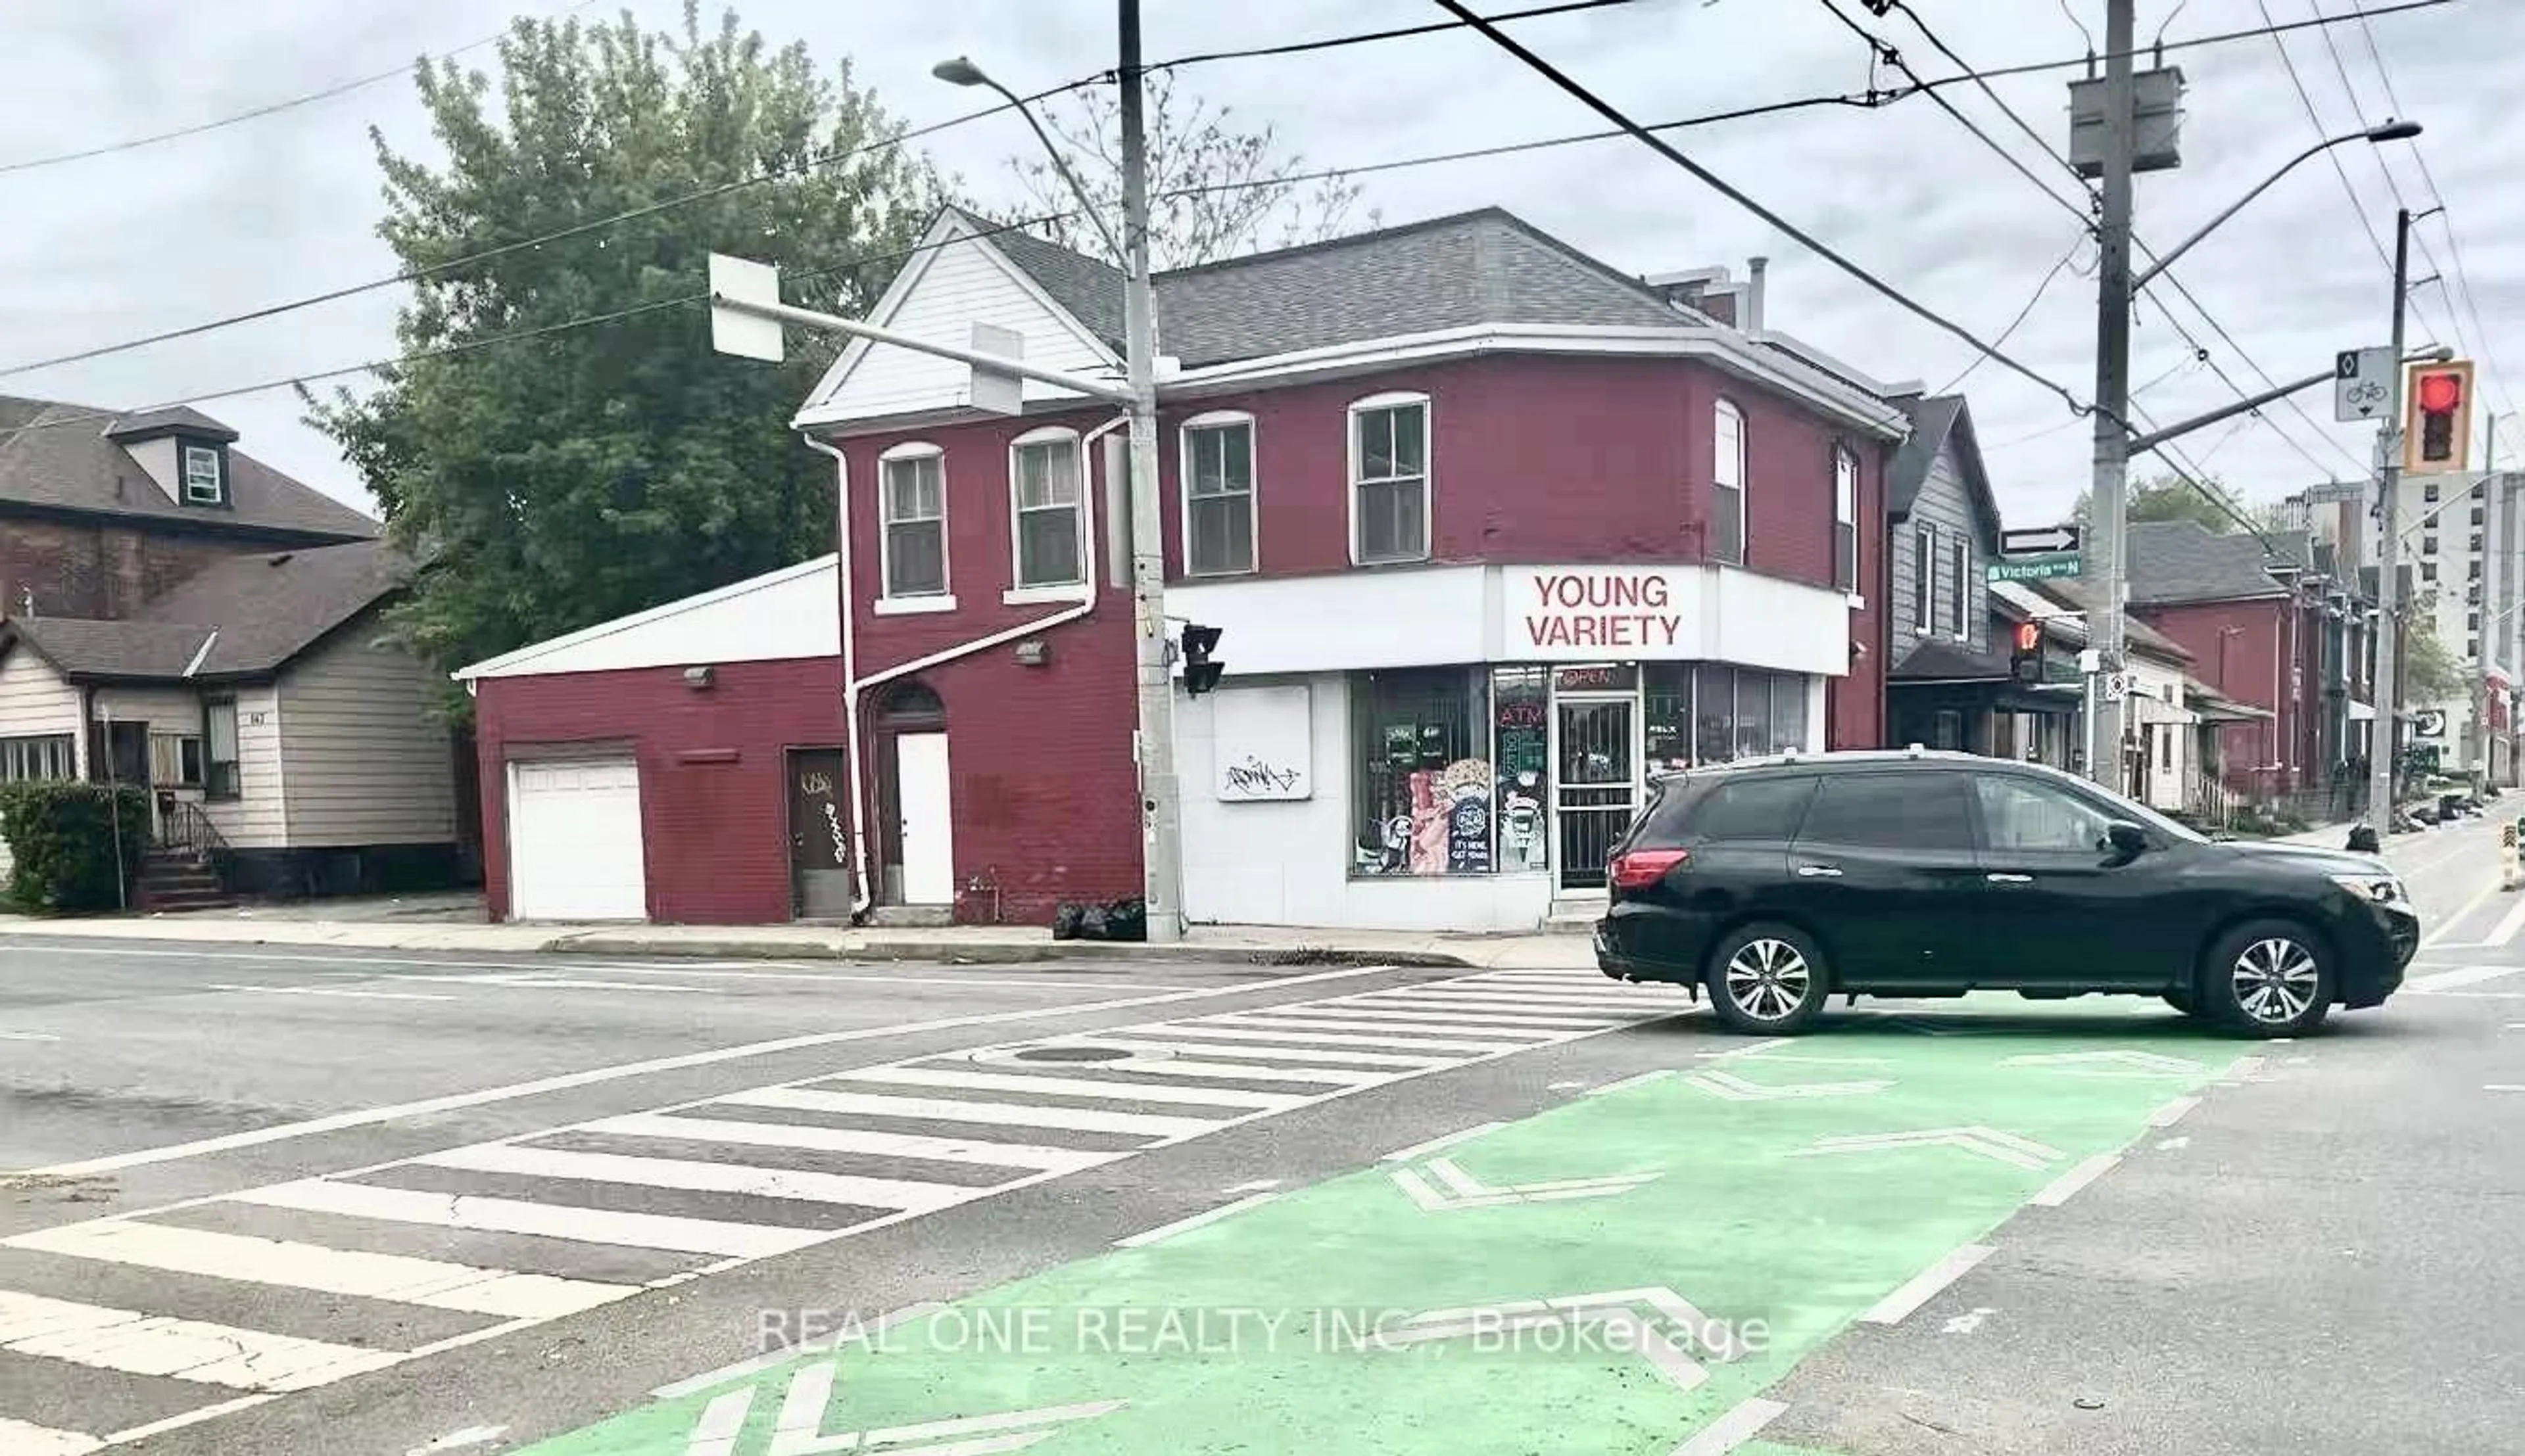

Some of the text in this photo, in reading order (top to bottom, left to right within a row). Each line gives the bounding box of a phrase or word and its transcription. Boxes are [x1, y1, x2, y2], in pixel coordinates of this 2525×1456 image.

[2001, 565, 2052, 579] Victoria
[2067, 561, 2079, 574] N
[1534, 576, 1668, 607] YOUNG
[1526, 615, 1681, 646] VARIETY
[1563, 669, 1610, 686] OPEN
[1501, 705, 1543, 724] ATM
